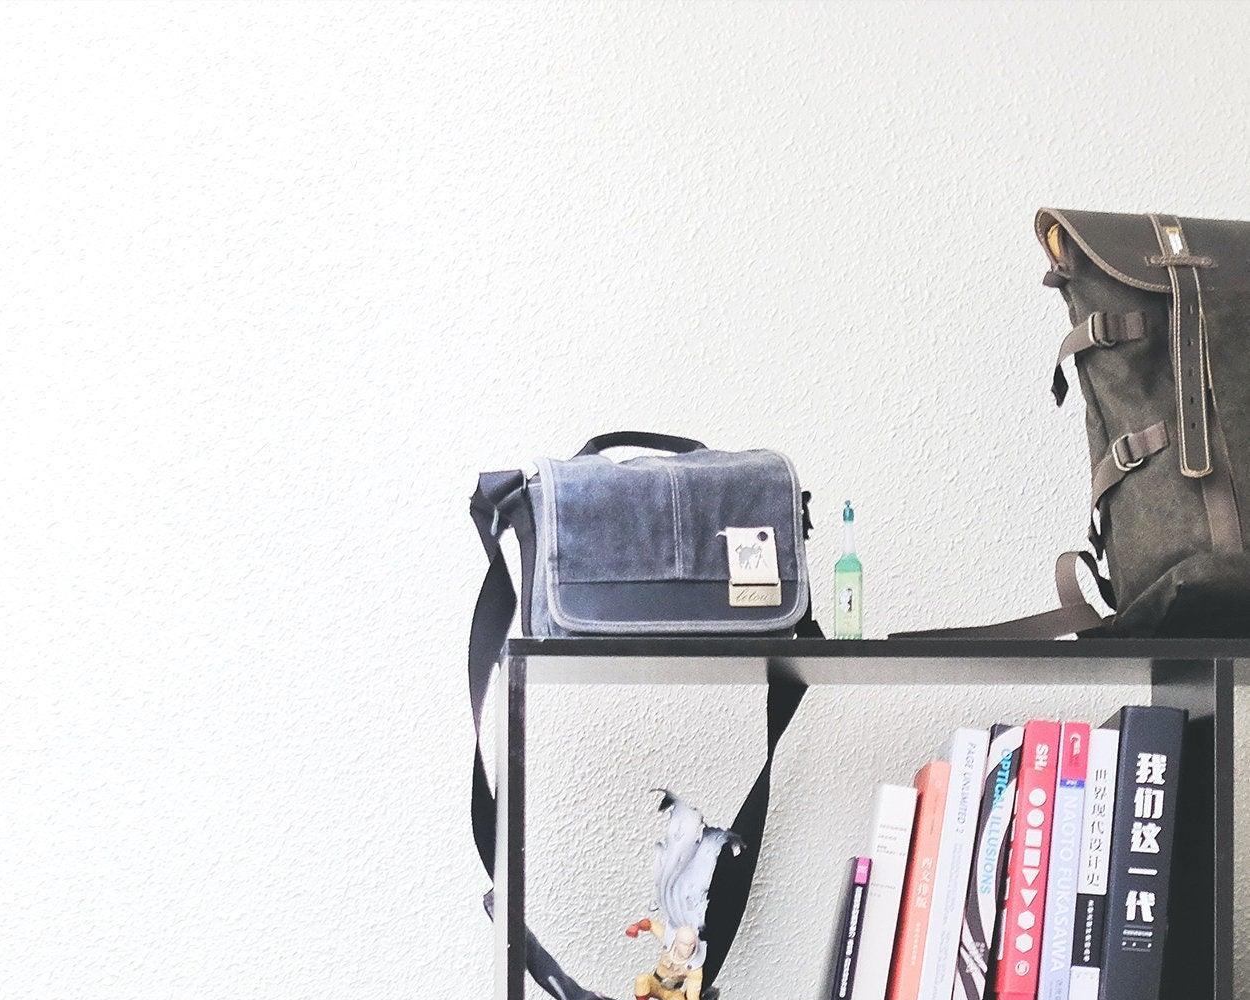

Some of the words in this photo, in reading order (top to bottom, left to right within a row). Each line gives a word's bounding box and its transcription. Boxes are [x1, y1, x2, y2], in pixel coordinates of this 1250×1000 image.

[993, 748, 1014, 812] OPTICAL
[979, 816, 1001, 895] ILLUSIONS
[1060, 796, 1078, 862] NAOTO
[1087, 769, 1107, 886] 世界现代设计史
[1125, 753, 1168, 922] 我们这一代
[1051, 867, 1074, 972] FUKASAWA
